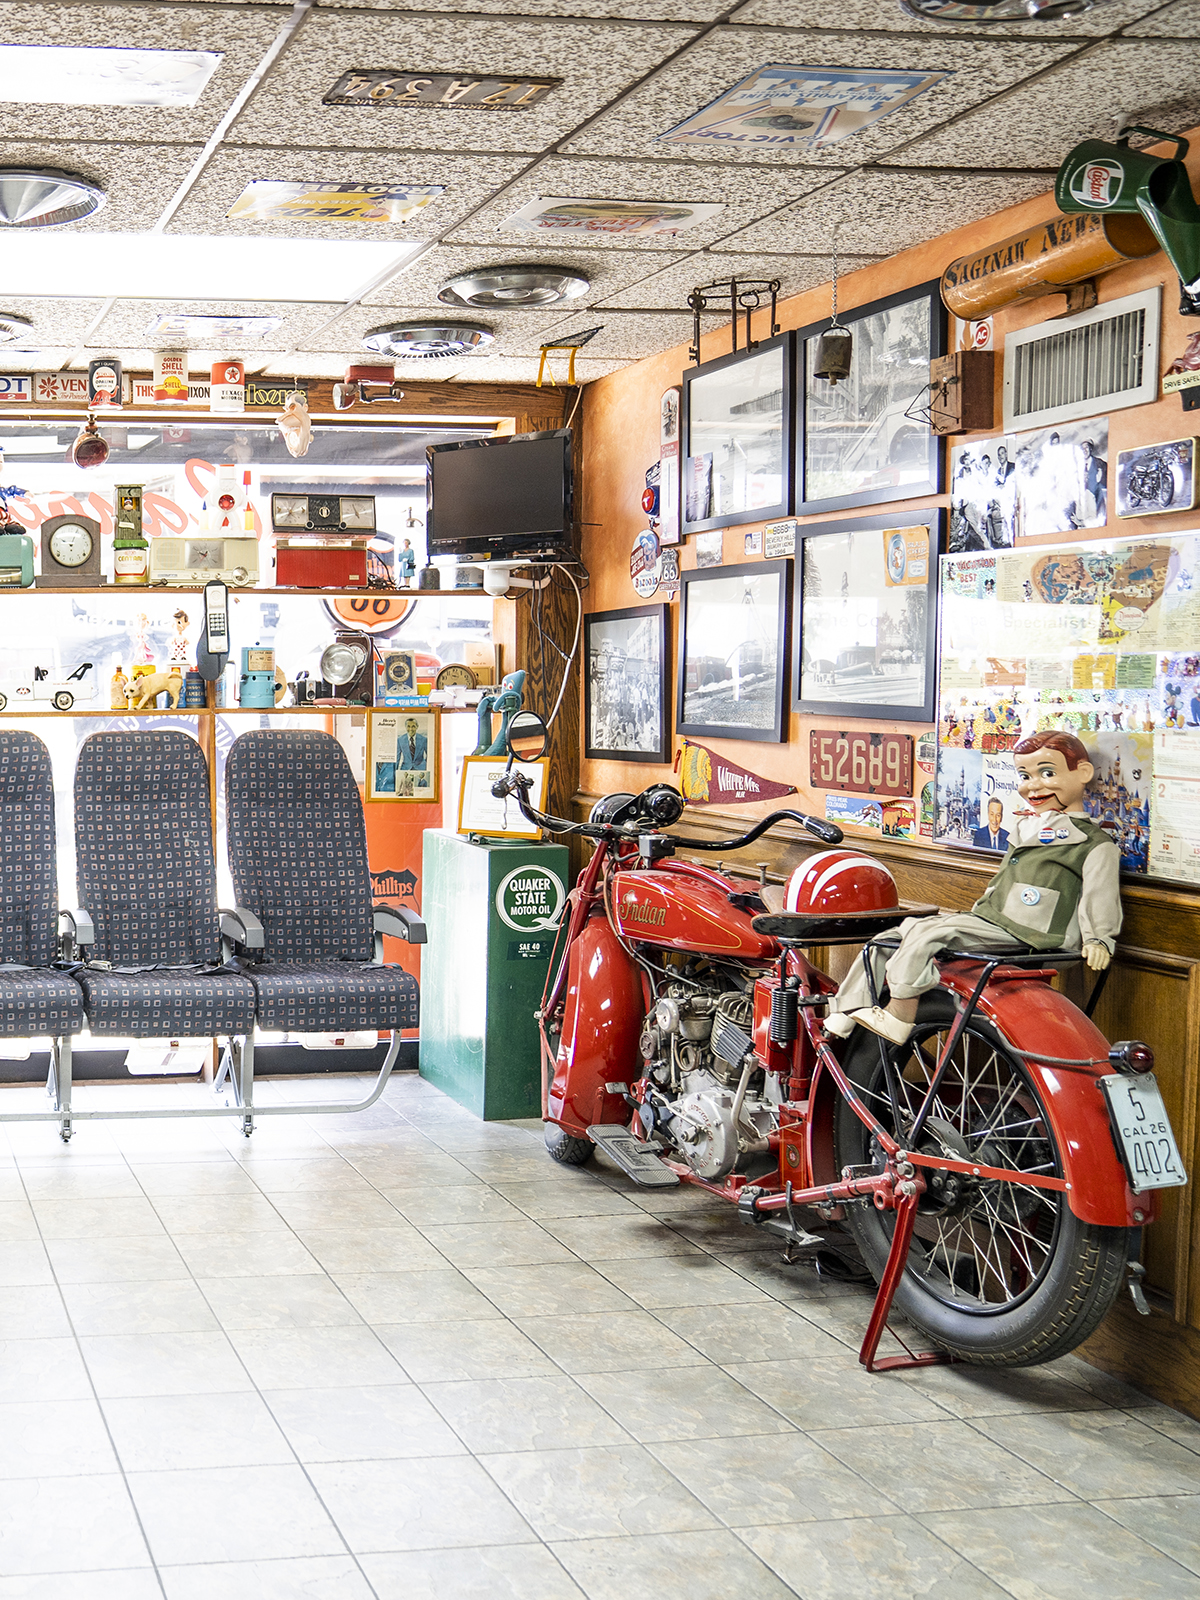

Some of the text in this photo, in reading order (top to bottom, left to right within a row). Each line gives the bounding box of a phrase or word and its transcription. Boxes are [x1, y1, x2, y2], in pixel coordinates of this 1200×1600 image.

[344, 76, 551, 105] 12 A 394
[682, 129, 795, 143] VICTORY
[354, 185, 428, 195] ROOT
[1087, 166, 1110, 203] Castrol
[944, 238, 1030, 291] SAGINAW
[975, 329, 988, 342] AC
[1163, 379, 1180, 390] DRIVE
[662, 444, 675, 452] Cream
[766, 534, 795, 545] BEVERLY HILLS
[956, 558, 996, 570] VACATION
[663, 565, 676, 580] 66
[960, 573, 978, 583] BEST
[819, 737, 900, 789] 52689
[717, 765, 761, 793] WHITE MTS.
[984, 773, 1019, 798] Disneyla
[1158, 783, 1166, 798] 2
[826, 801, 848, 810] COLORADO
[902, 809, 915, 820] PARK
[509, 877, 551, 892] QUAKER
[515, 891, 546, 906] STATE
[510, 904, 551, 917] MOTOR OIL
[618, 889, 667, 928] Indian
[519, 942, 541, 951] SAE 40
[1126, 1086, 1145, 1122] 5
[1122, 1123, 1167, 1138] CAL 26
[1133, 1140, 1179, 1176] 402
